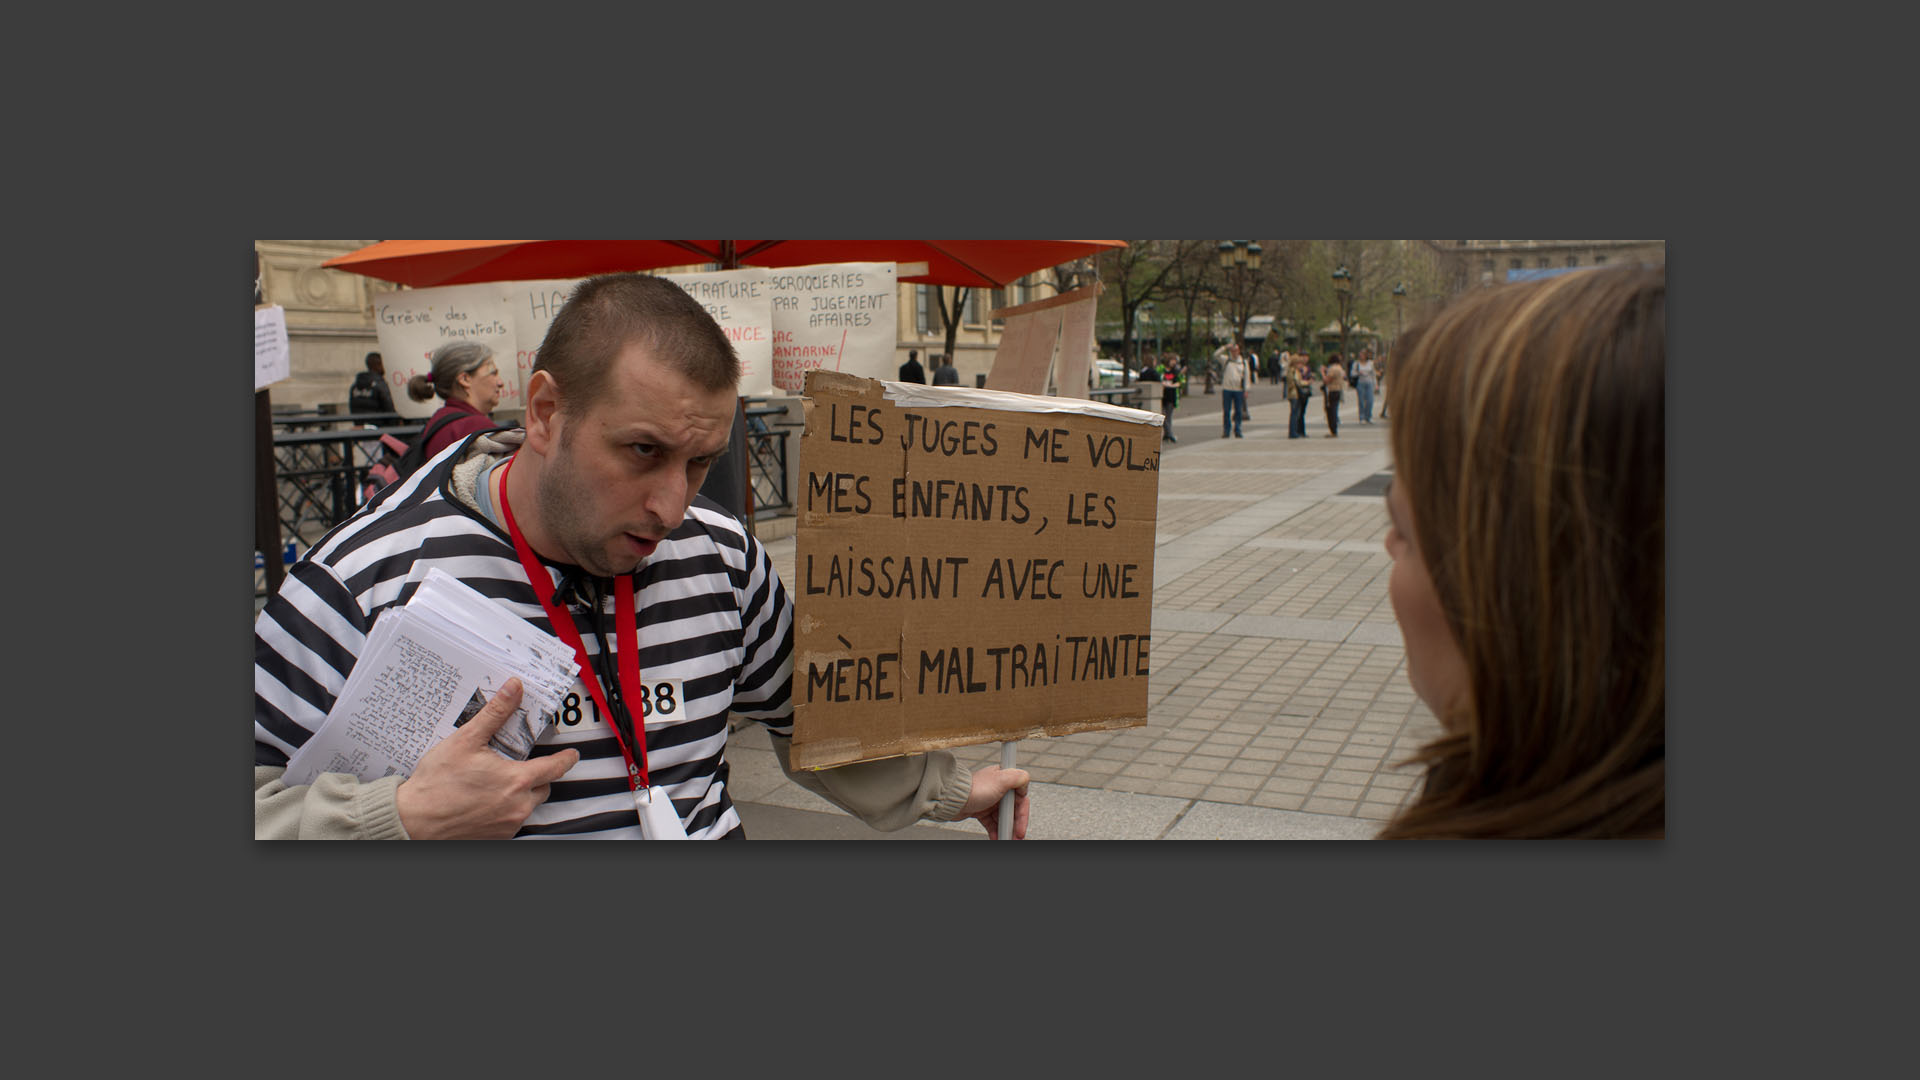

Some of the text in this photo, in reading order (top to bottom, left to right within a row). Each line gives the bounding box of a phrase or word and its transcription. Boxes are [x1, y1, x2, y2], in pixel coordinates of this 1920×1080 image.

[445, 306, 467, 320] des
[773, 292, 889, 311] PAR JUGEMENT
[724, 327, 767, 342] ANCE
[809, 312, 872, 328] AFFAIRES
[830, 403, 884, 445] LES
[901, 414, 998, 456] JUGES
[1024, 427, 1070, 463] ME
[807, 472, 872, 514] MES
[1067, 493, 1117, 529] LES
[981, 558, 1065, 600] AVEC
[1082, 562, 1139, 599] UNE
[807, 634, 899, 703] MÈRE
